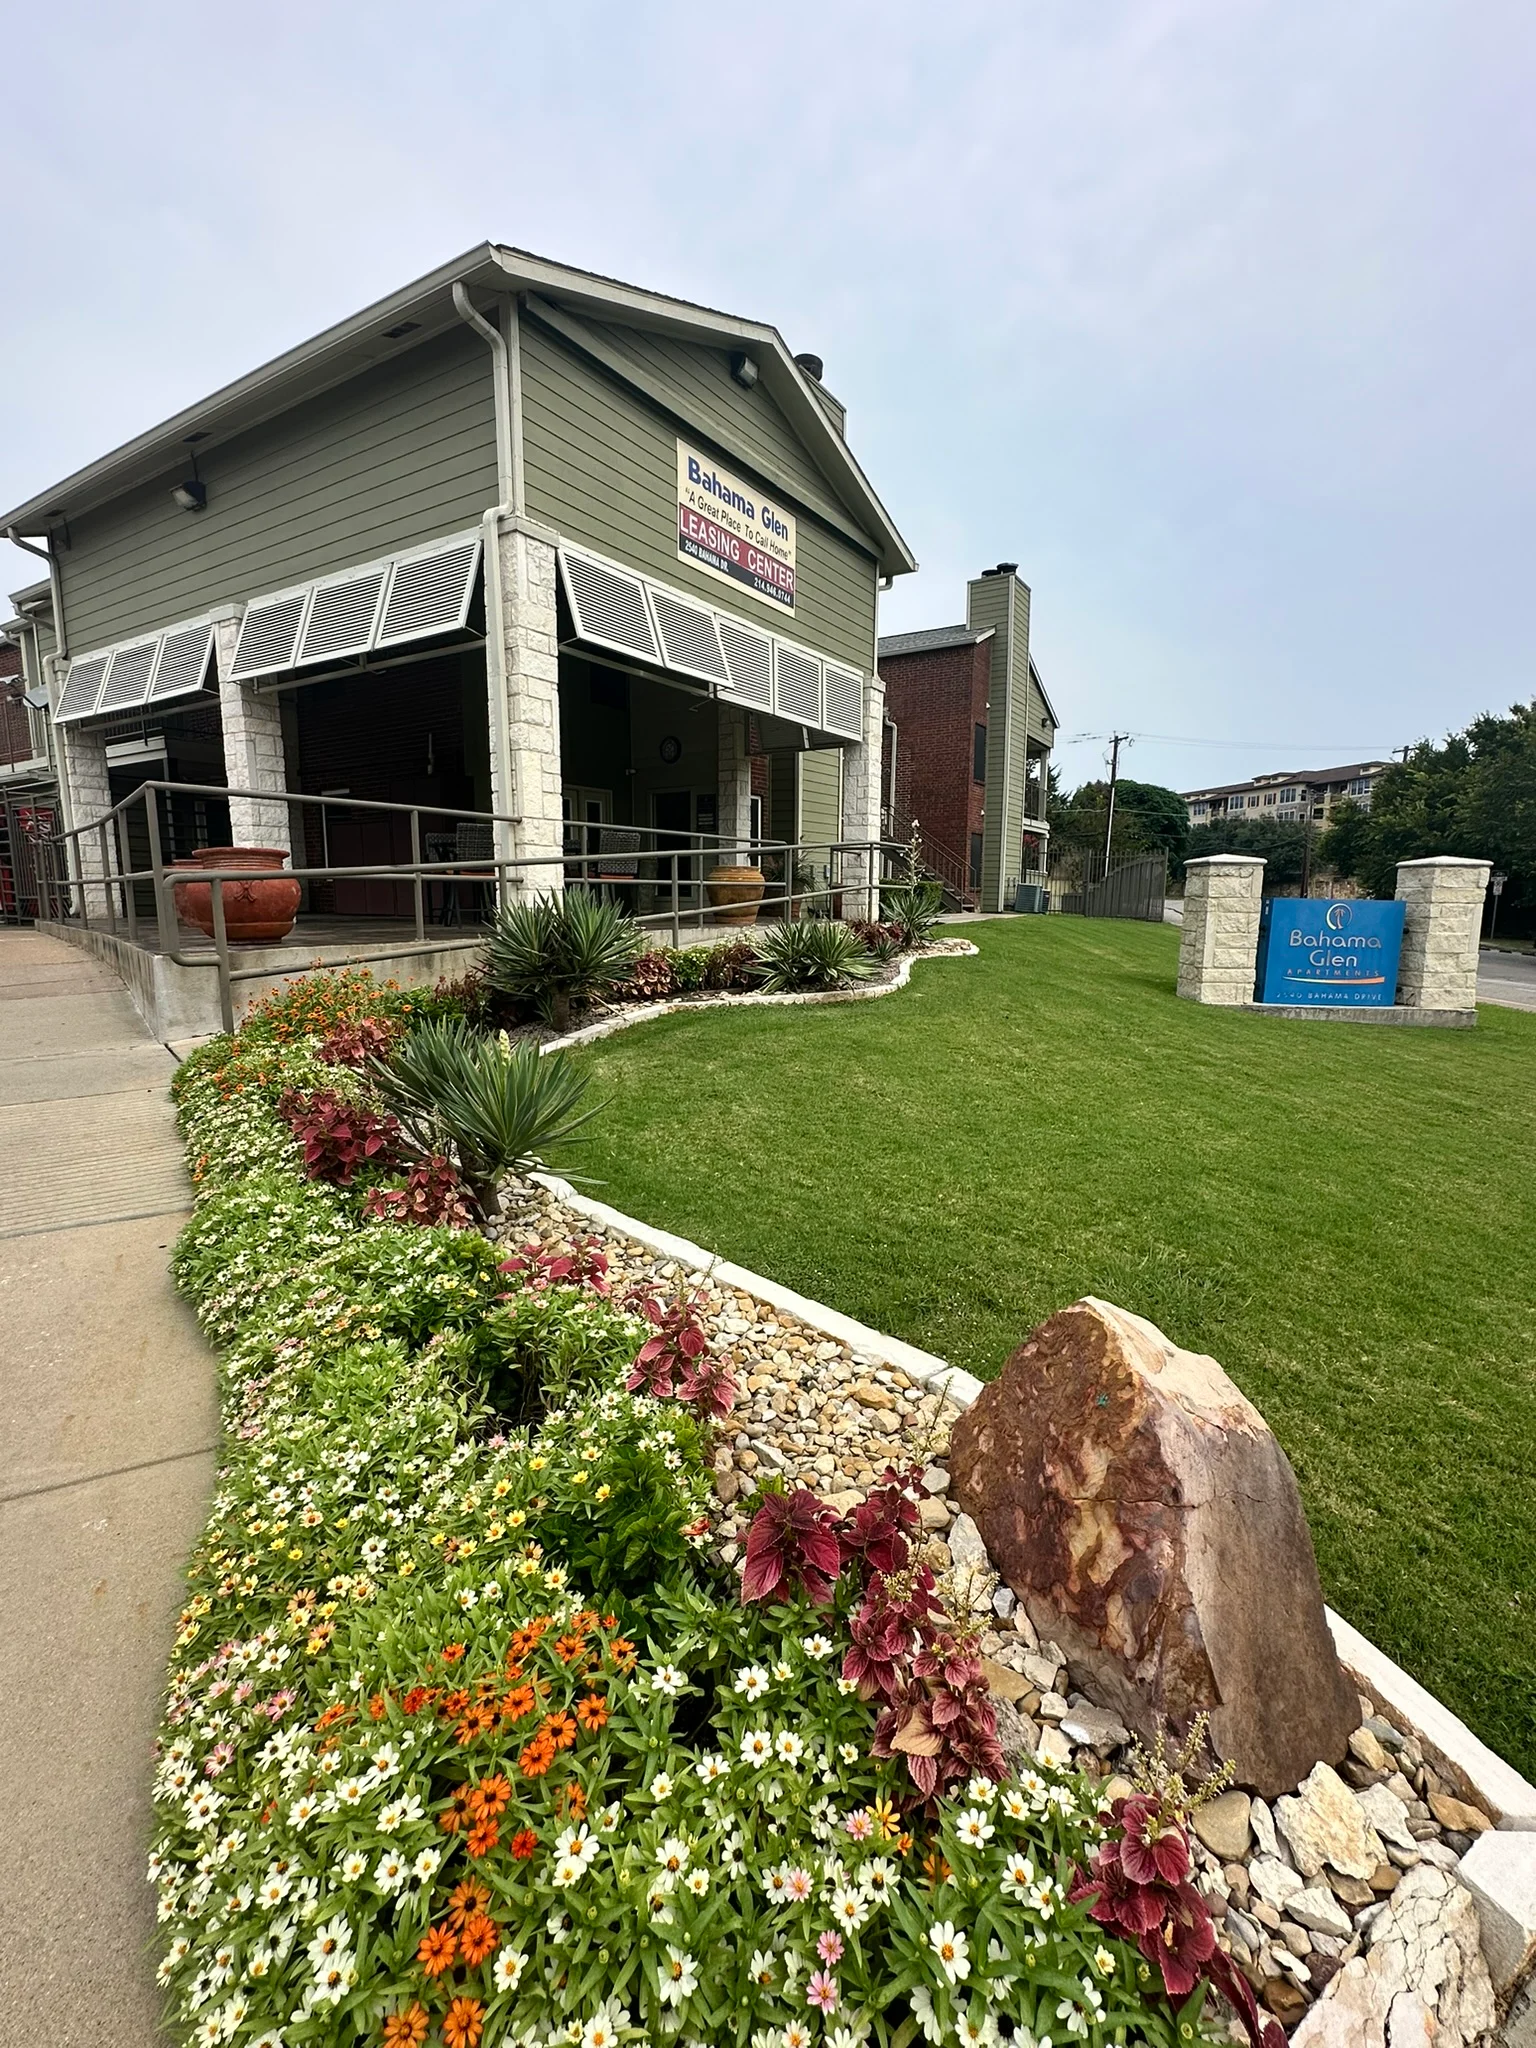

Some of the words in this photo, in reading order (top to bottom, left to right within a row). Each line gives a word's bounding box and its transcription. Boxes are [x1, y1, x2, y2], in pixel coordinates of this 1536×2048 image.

[688, 455, 755, 520] Bahama
[761, 506, 789, 541] Glen
[698, 496, 720, 520] Great
[720, 509, 741, 532] Place
[745, 524, 754, 541] To
[755, 531, 769, 550] Call
[680, 508, 740, 561] LEASING
[747, 549, 794, 591] CENTER
[685, 540, 698, 556] 2540
[698, 546, 720, 568] BAHAMA
[1289, 929, 1382, 949] Bahama
[1309, 949, 1358, 967] Glen
[1287, 968, 1380, 977] APARTMENTS
[1307, 992, 1349, 1000] BAHAMA
[1354, 992, 1383, 1001] DRIVE
